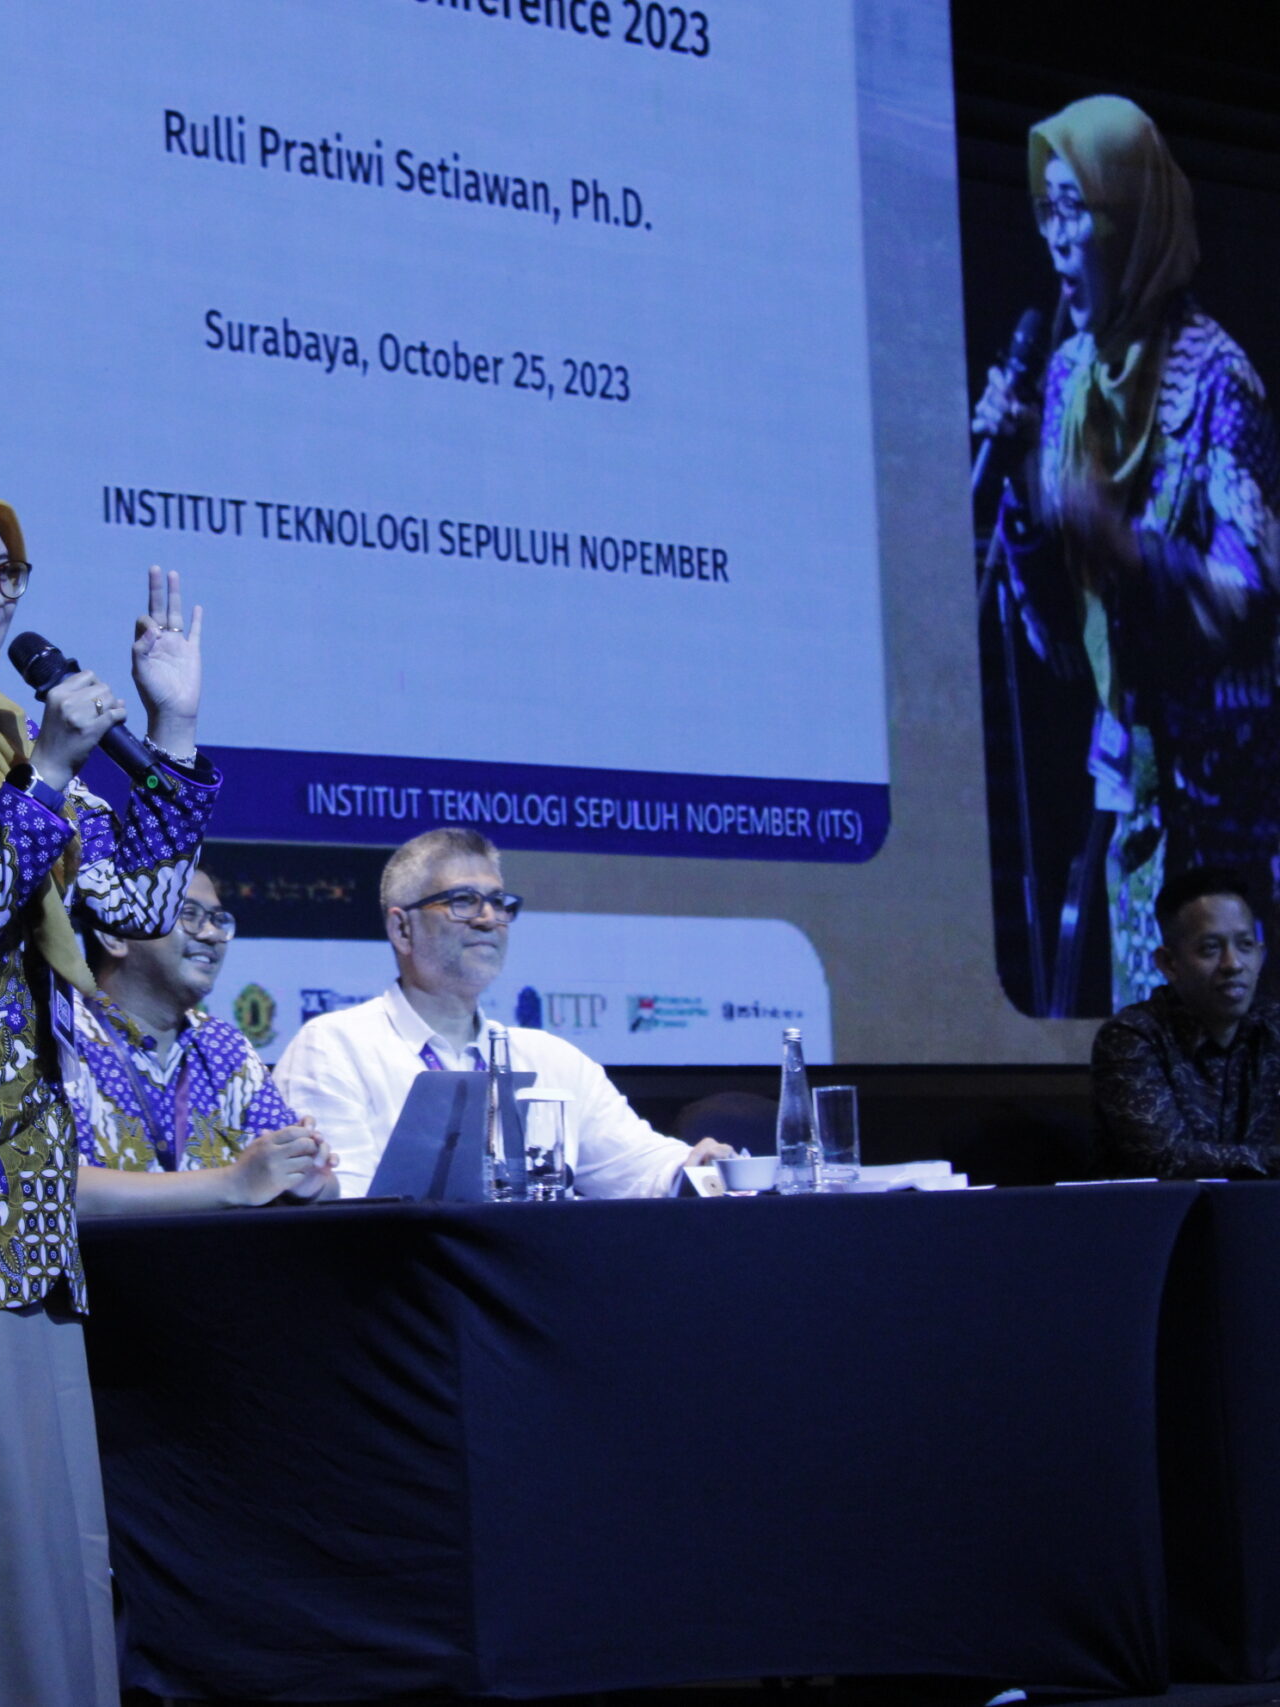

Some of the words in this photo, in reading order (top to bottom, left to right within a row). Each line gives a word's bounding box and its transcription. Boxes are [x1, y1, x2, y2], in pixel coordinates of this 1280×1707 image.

[621, 0, 711, 58] 2023
[163, 109, 246, 165] Rulli
[259, 125, 384, 187] Pratiwi
[395, 148, 561, 224] Setiawan,
[571, 178, 653, 231] Ph.D.
[204, 309, 369, 375] Surabaya,
[378, 333, 504, 385] October
[512, 351, 555, 400] 25,
[562, 358, 631, 402] 2023
[102, 486, 247, 536] INSTITUT
[255, 501, 429, 554] TEKNOLOGI
[438, 519, 570, 567] SEPULUH
[579, 535, 730, 583] NOPEMBER
[307, 783, 422, 819] INSTITUT
[428, 788, 567, 826] TEKNOLOGI
[574, 796, 678, 831] SEPULUH
[686, 803, 811, 837] NOPEMBER
[818, 809, 863, 844] (ITS)
[545, 993, 607, 1028] UTP
